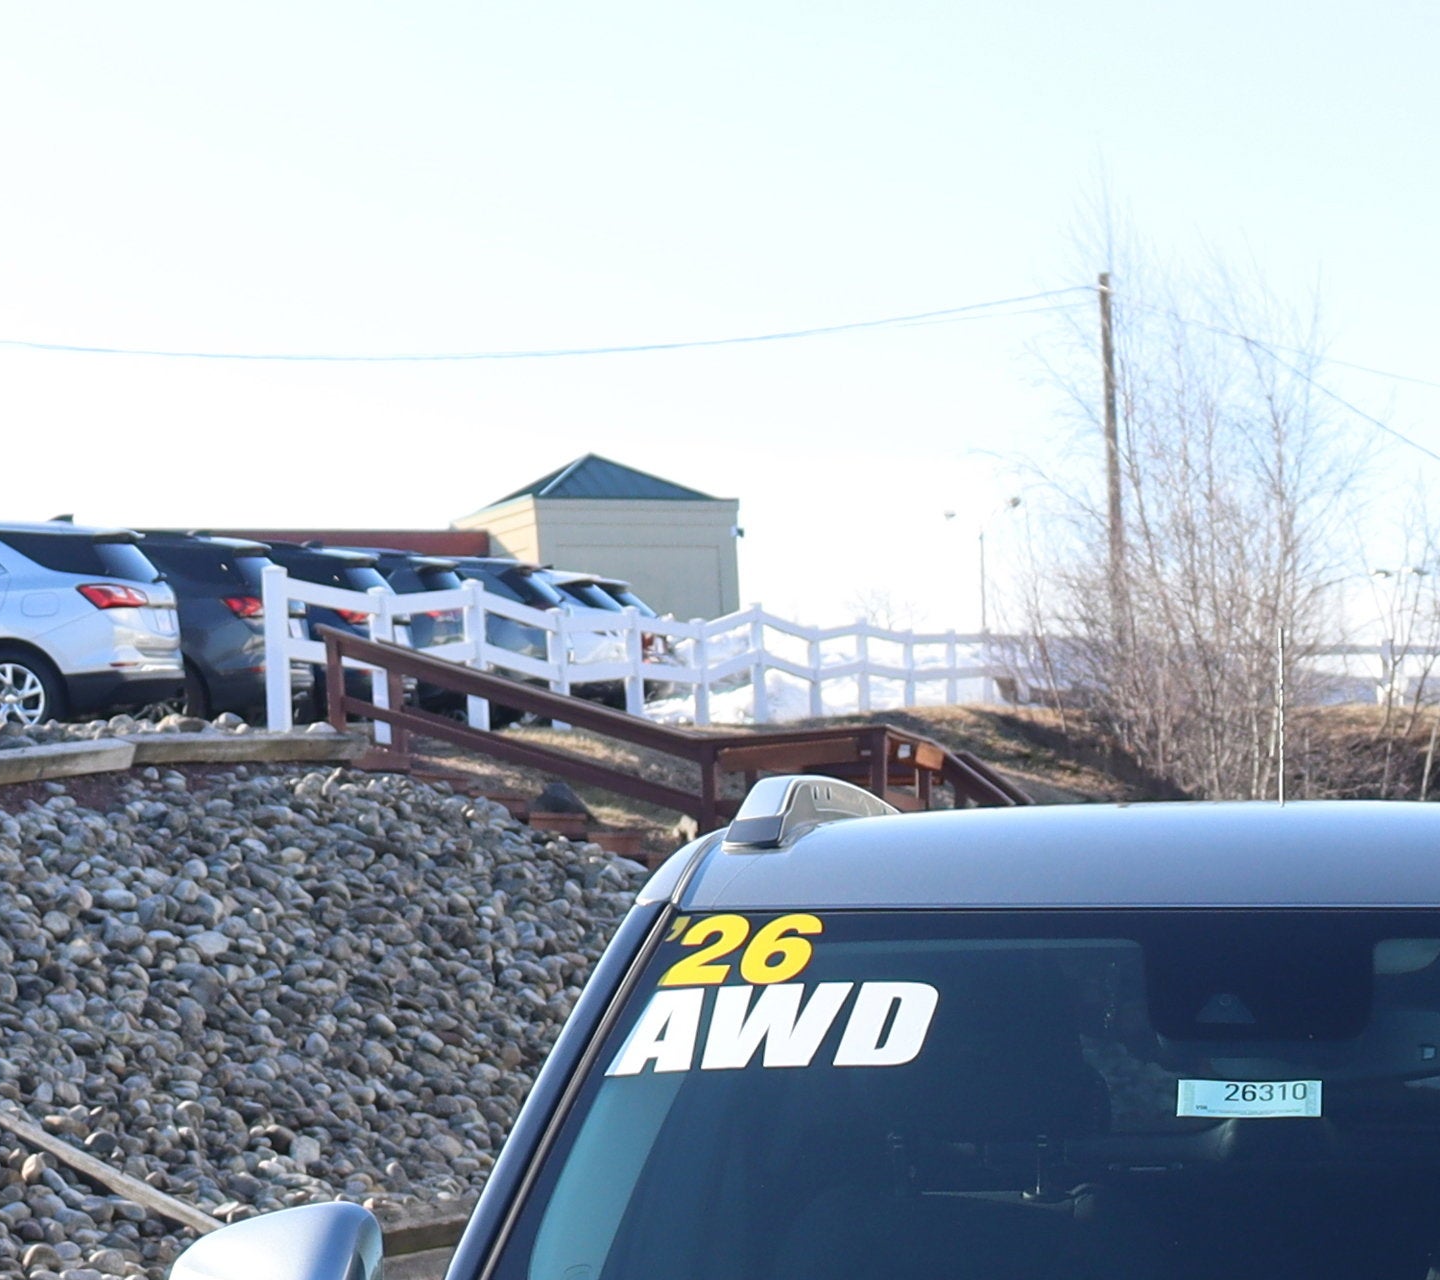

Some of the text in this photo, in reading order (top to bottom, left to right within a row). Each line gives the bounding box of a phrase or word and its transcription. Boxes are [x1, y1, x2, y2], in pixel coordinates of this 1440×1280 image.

[657, 912, 825, 986] '26
[603, 981, 940, 1077] AWD
[1224, 1082, 1308, 1102] 26310
